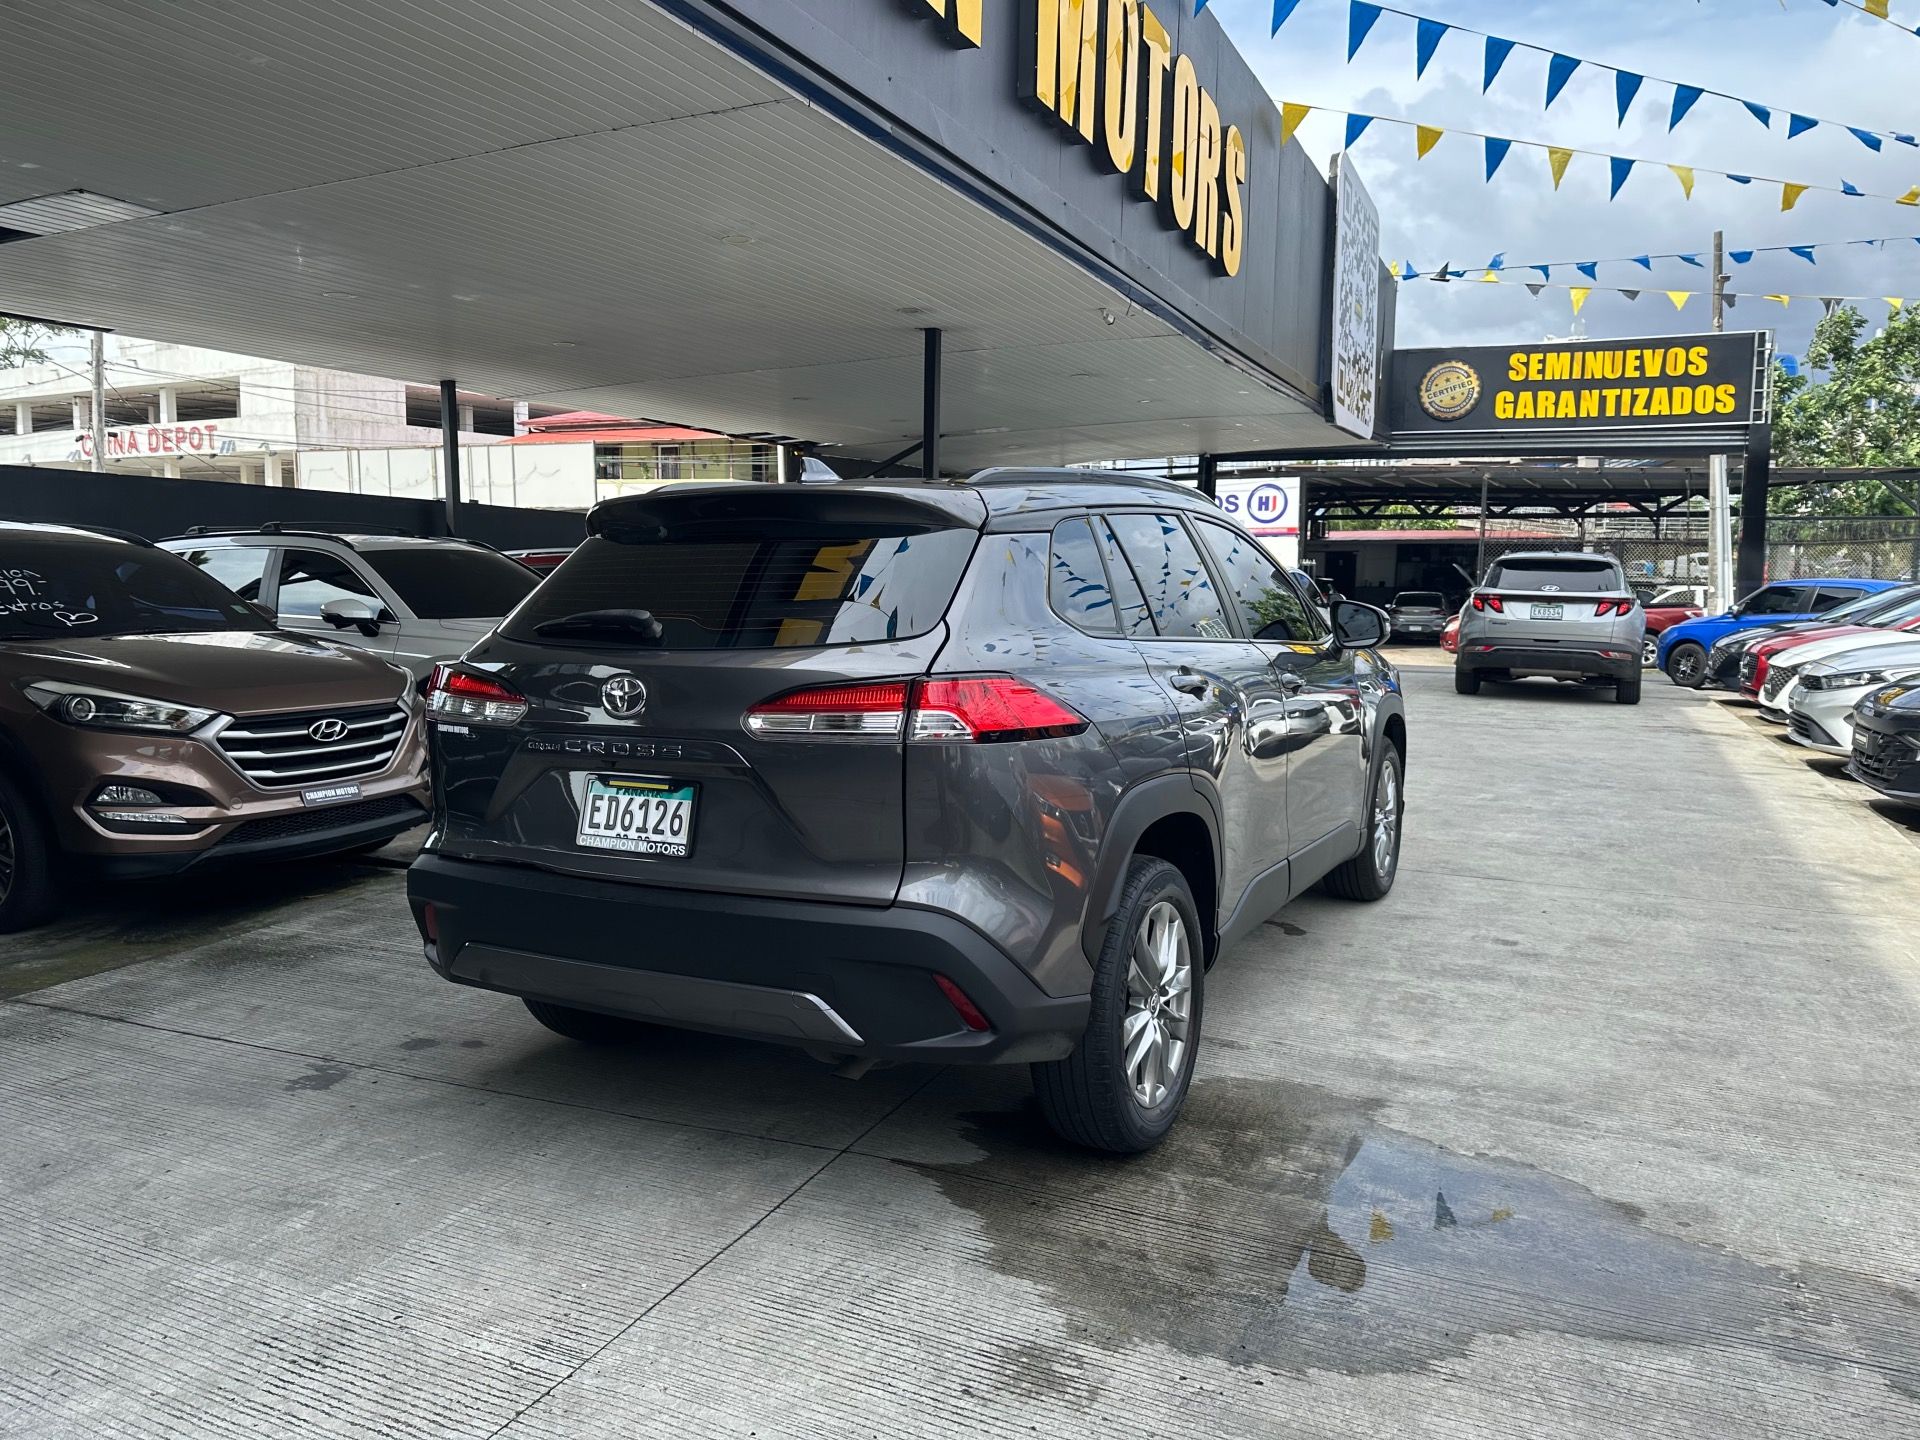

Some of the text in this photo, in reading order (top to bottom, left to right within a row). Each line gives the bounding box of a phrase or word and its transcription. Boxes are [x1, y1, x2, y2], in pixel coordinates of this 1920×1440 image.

[1036, 0, 1246, 278] MOTORS
[1508, 346, 1709, 381] SEMINUEVOS
[1427, 380, 1473, 400] CERTIFIED
[1494, 384, 1736, 419] GARANTIZADOS
[80, 424, 217, 457] CINA DEPOT
[1257, 495, 1277, 512] HJ
[564, 739, 682, 758] CROSS
[588, 794, 684, 837] ED6126
[579, 835, 636, 851] CHAMPION
[638, 840, 686, 856] MOTORS
